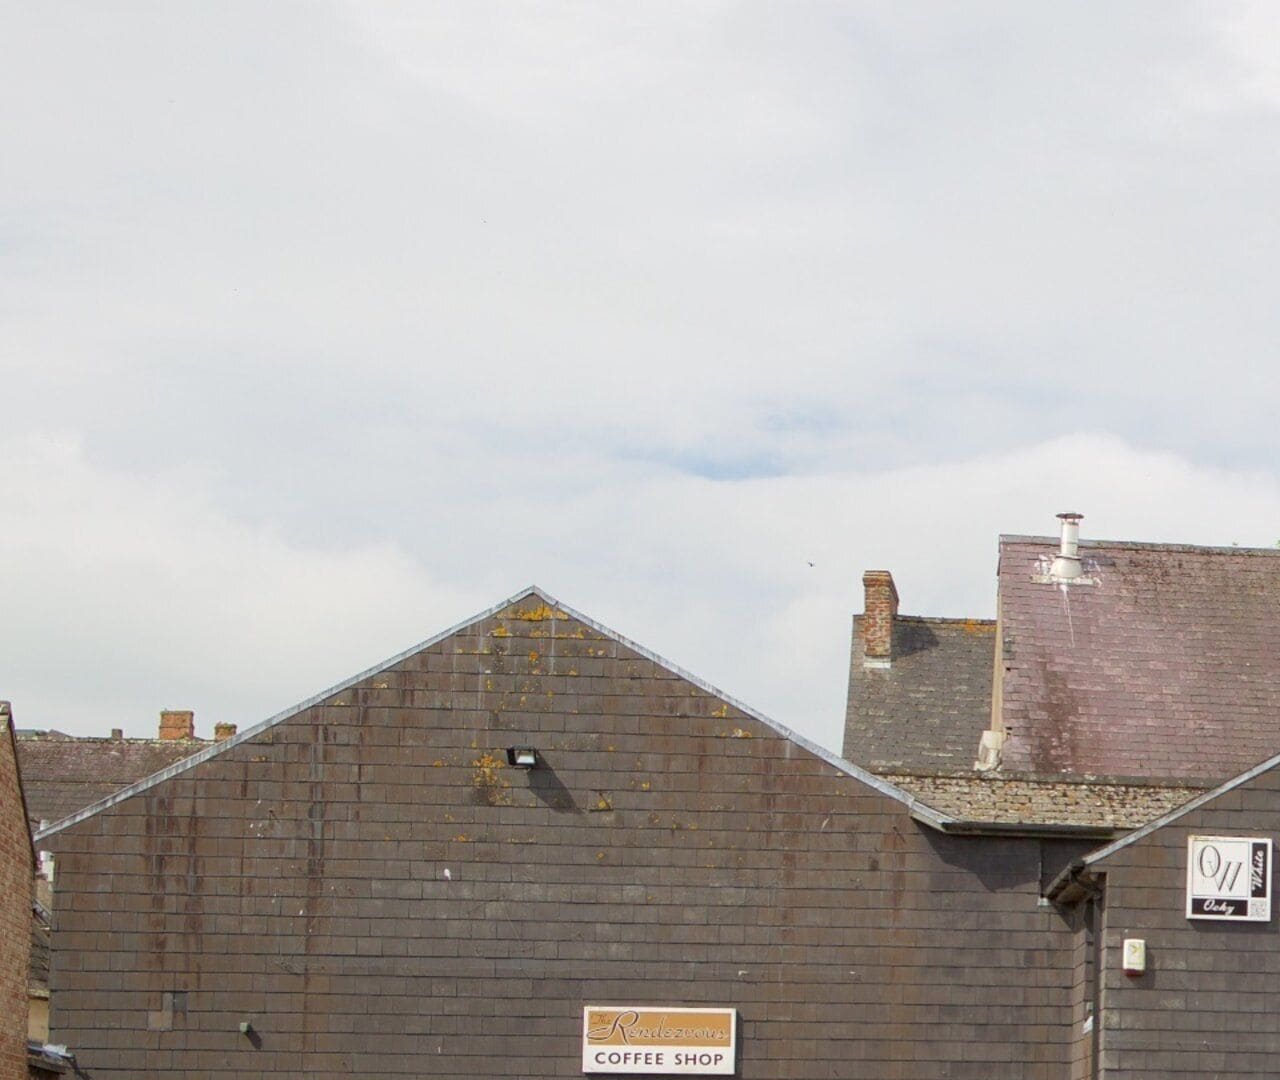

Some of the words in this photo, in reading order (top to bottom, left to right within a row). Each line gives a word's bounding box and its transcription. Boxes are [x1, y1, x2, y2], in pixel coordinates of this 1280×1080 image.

[1203, 899, 1236, 916] Ocky
[586, 1010, 729, 1045] Rendezvous
[594, 1052, 664, 1065] COFFEE
[674, 1053, 724, 1066] SHOP
